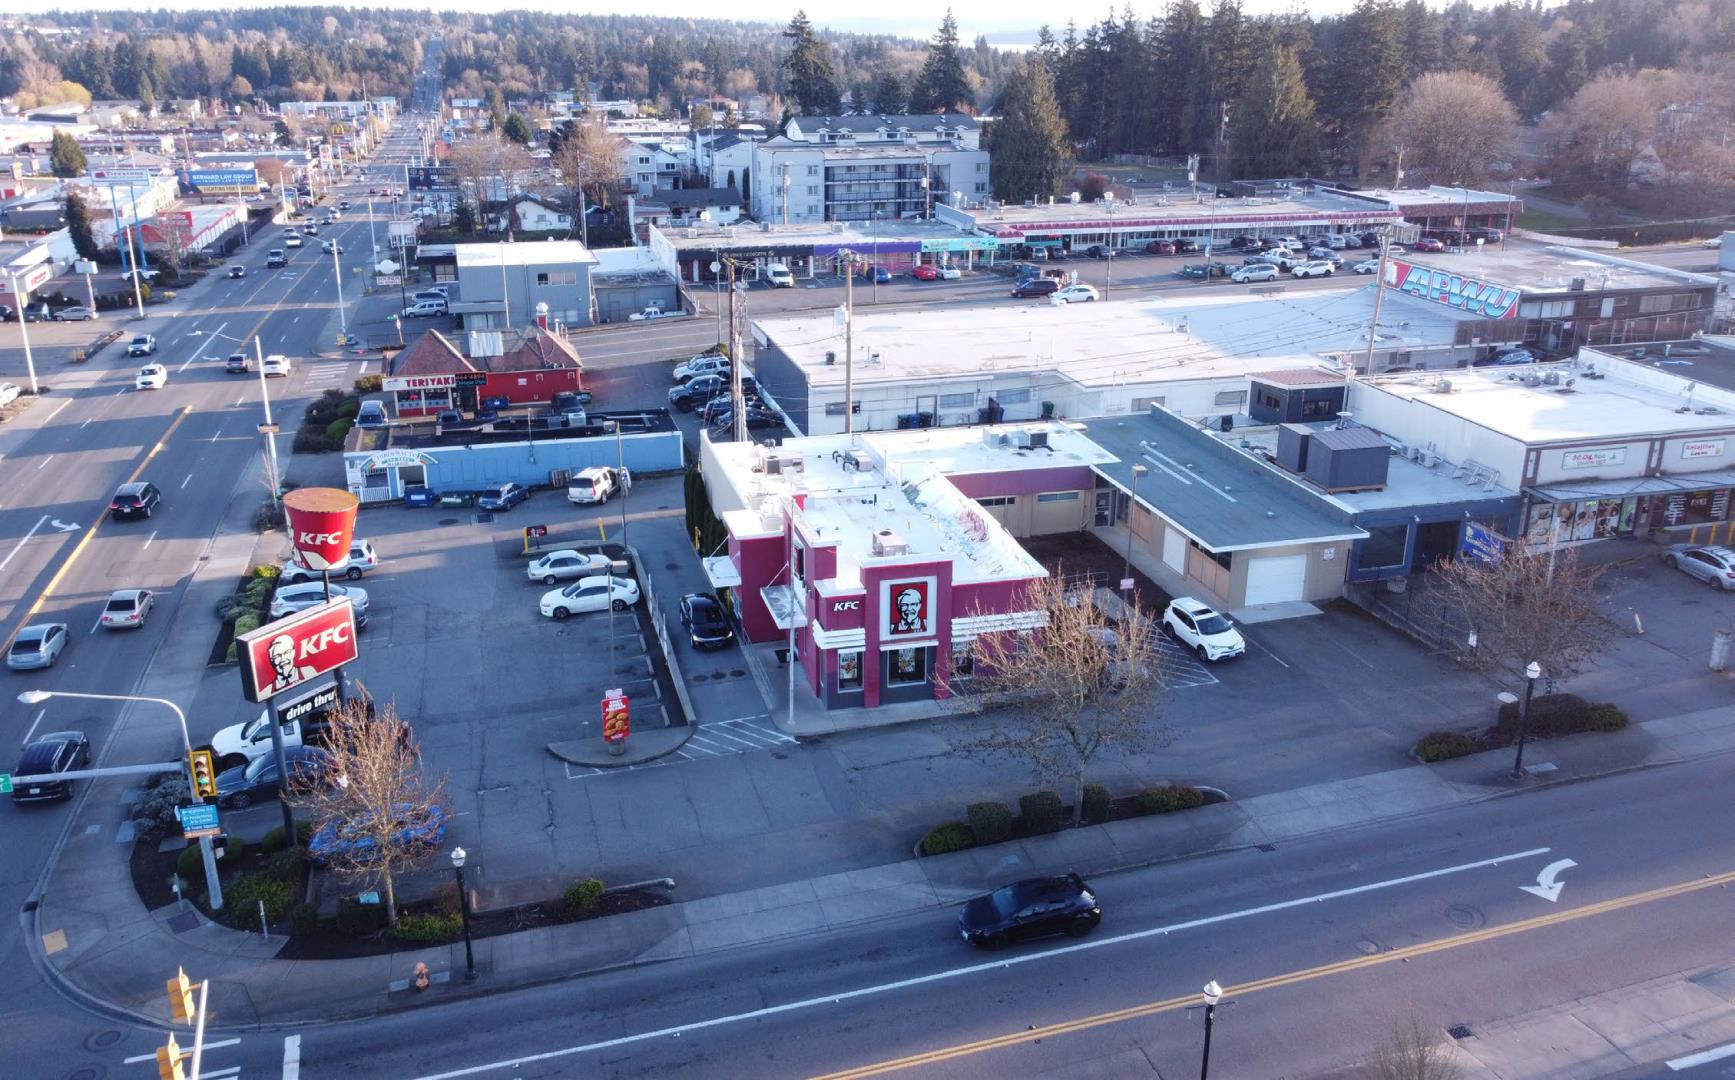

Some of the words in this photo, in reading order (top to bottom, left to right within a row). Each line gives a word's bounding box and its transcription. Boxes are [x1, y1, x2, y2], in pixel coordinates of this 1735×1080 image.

[406, 376, 456, 387] TERIYAKI
[300, 531, 343, 545] KFC
[834, 601, 860, 612] KFC
[299, 622, 350, 660] KFC
[286, 702, 312, 720] drive
[314, 690, 335, 708] thru
